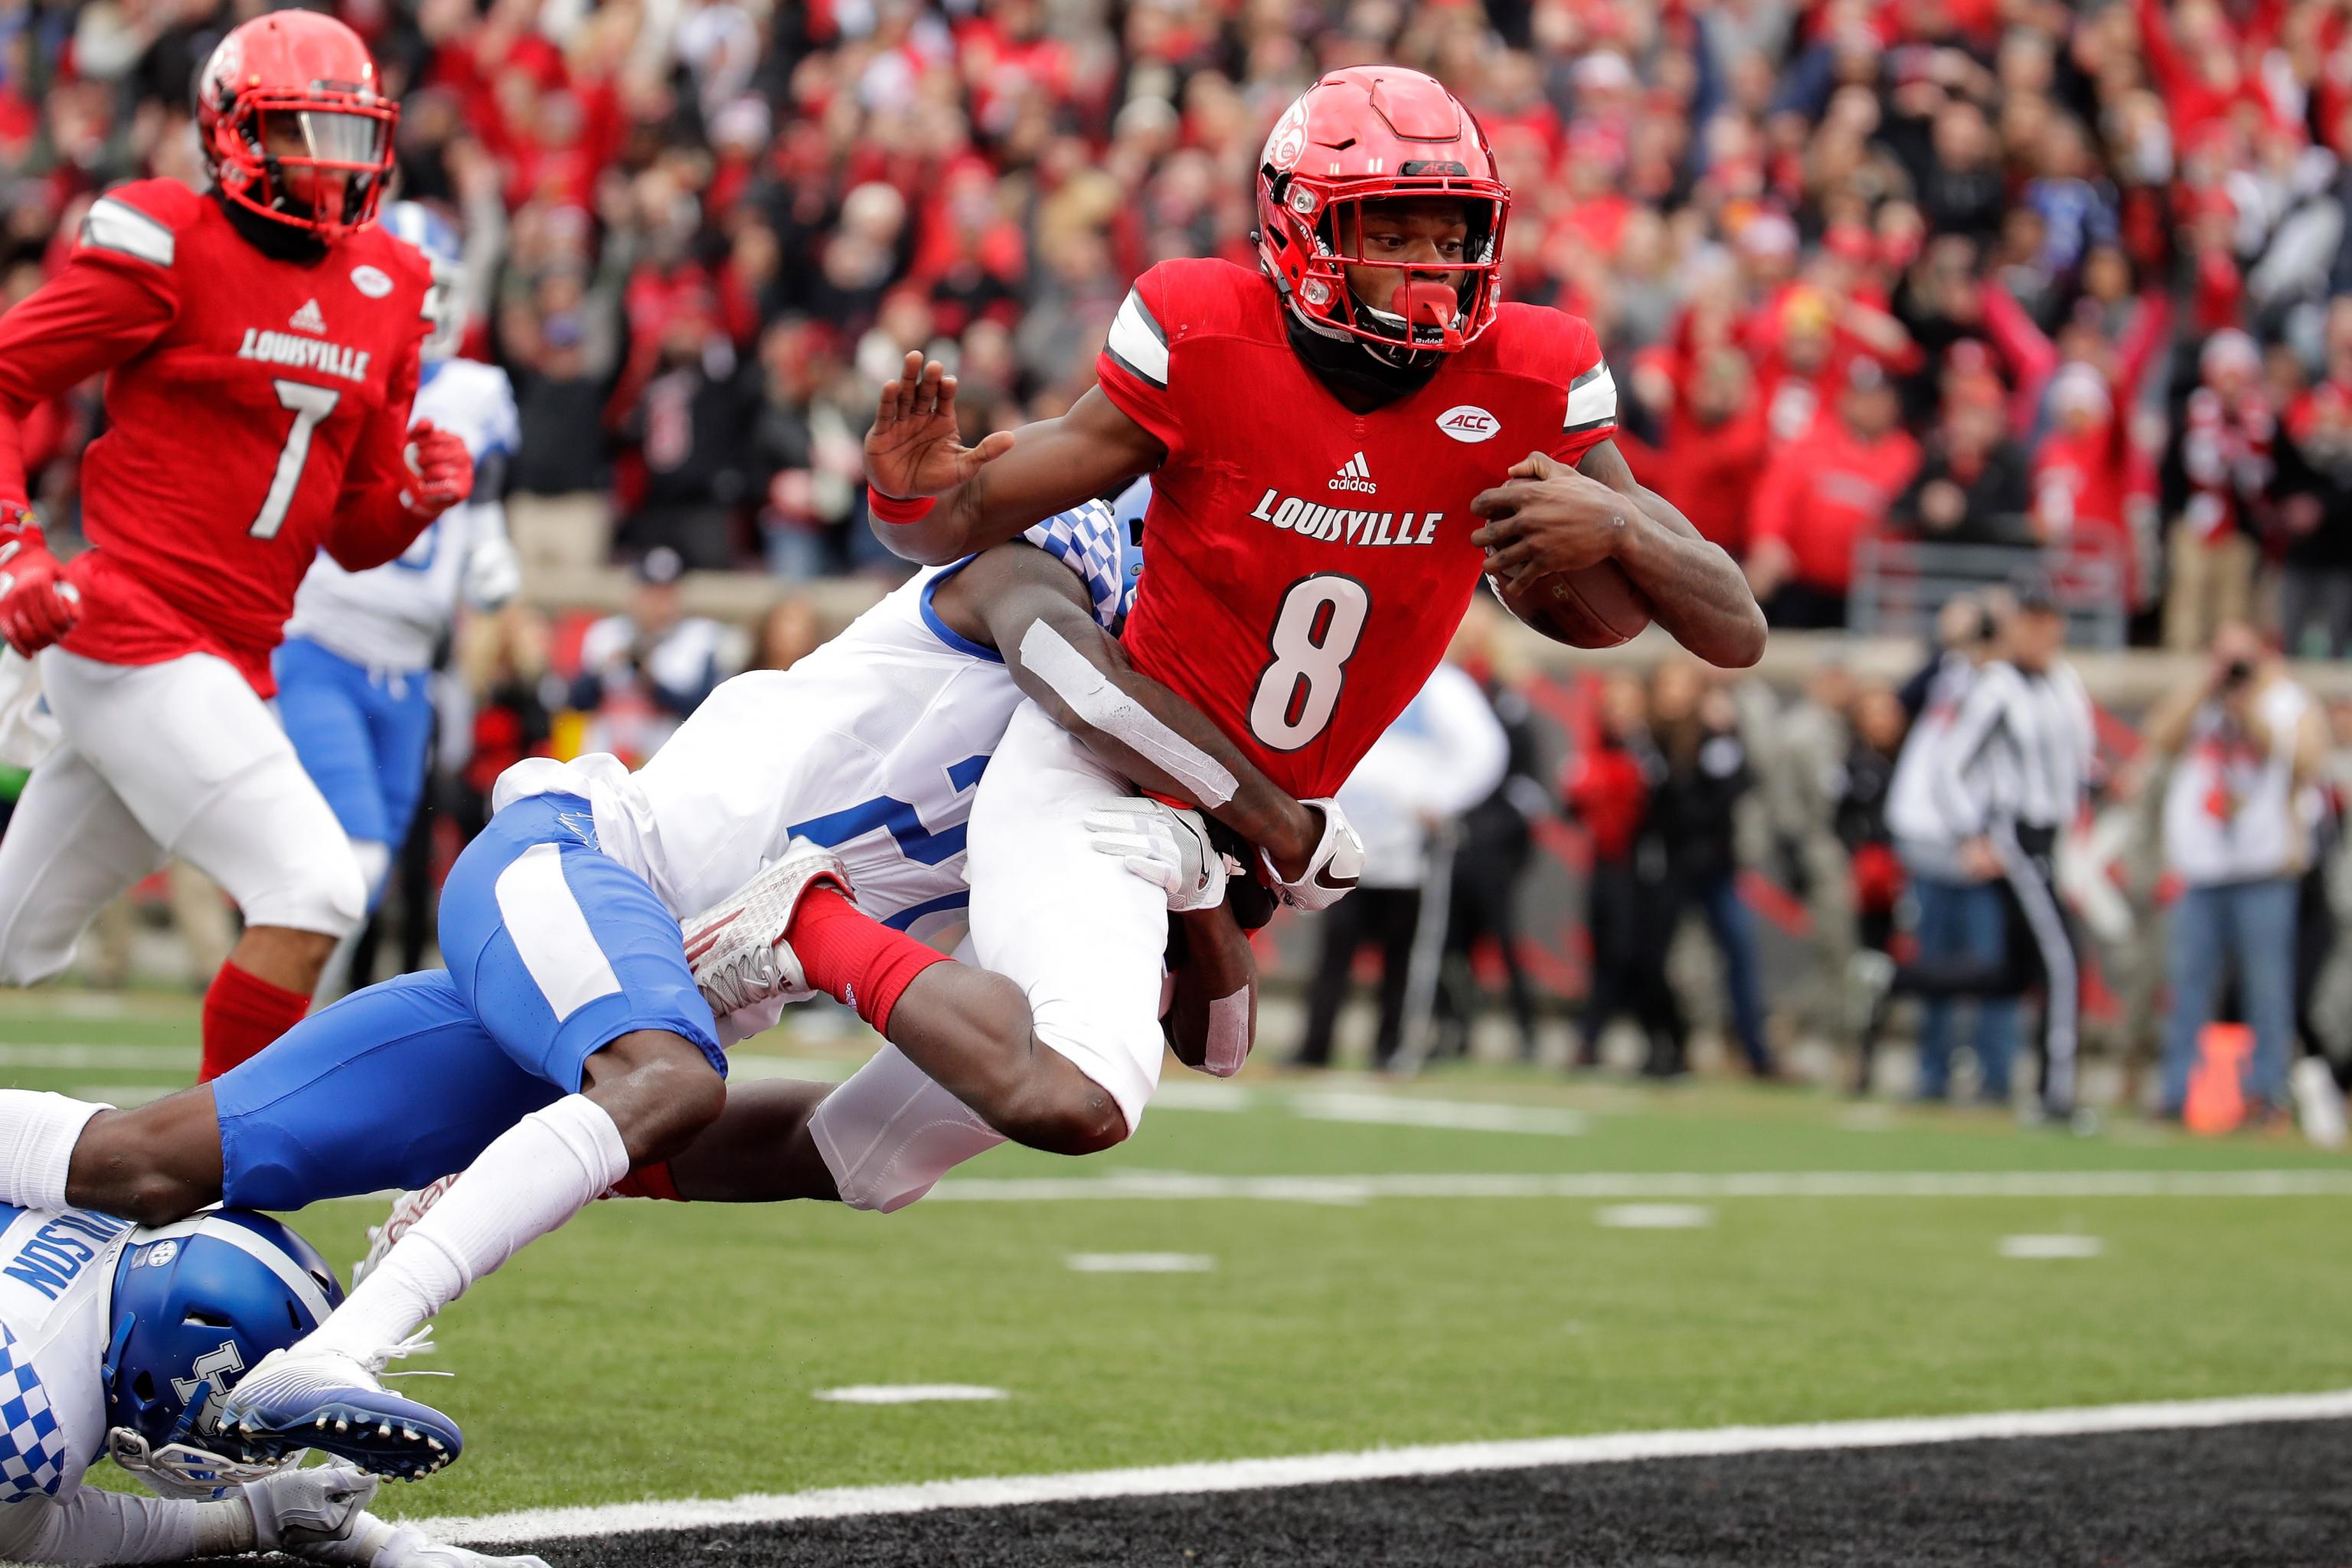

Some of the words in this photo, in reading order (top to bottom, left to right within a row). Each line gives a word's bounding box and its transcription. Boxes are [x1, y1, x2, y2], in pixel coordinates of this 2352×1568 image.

[237, 327, 371, 382] LOUISVILLE
[1446, 414, 1492, 430] ACC
[248, 378, 341, 540] 7
[1328, 476, 1377, 495] adidas
[1250, 488, 1444, 547] LOUISVILLE
[1246, 570, 1373, 753] 8
